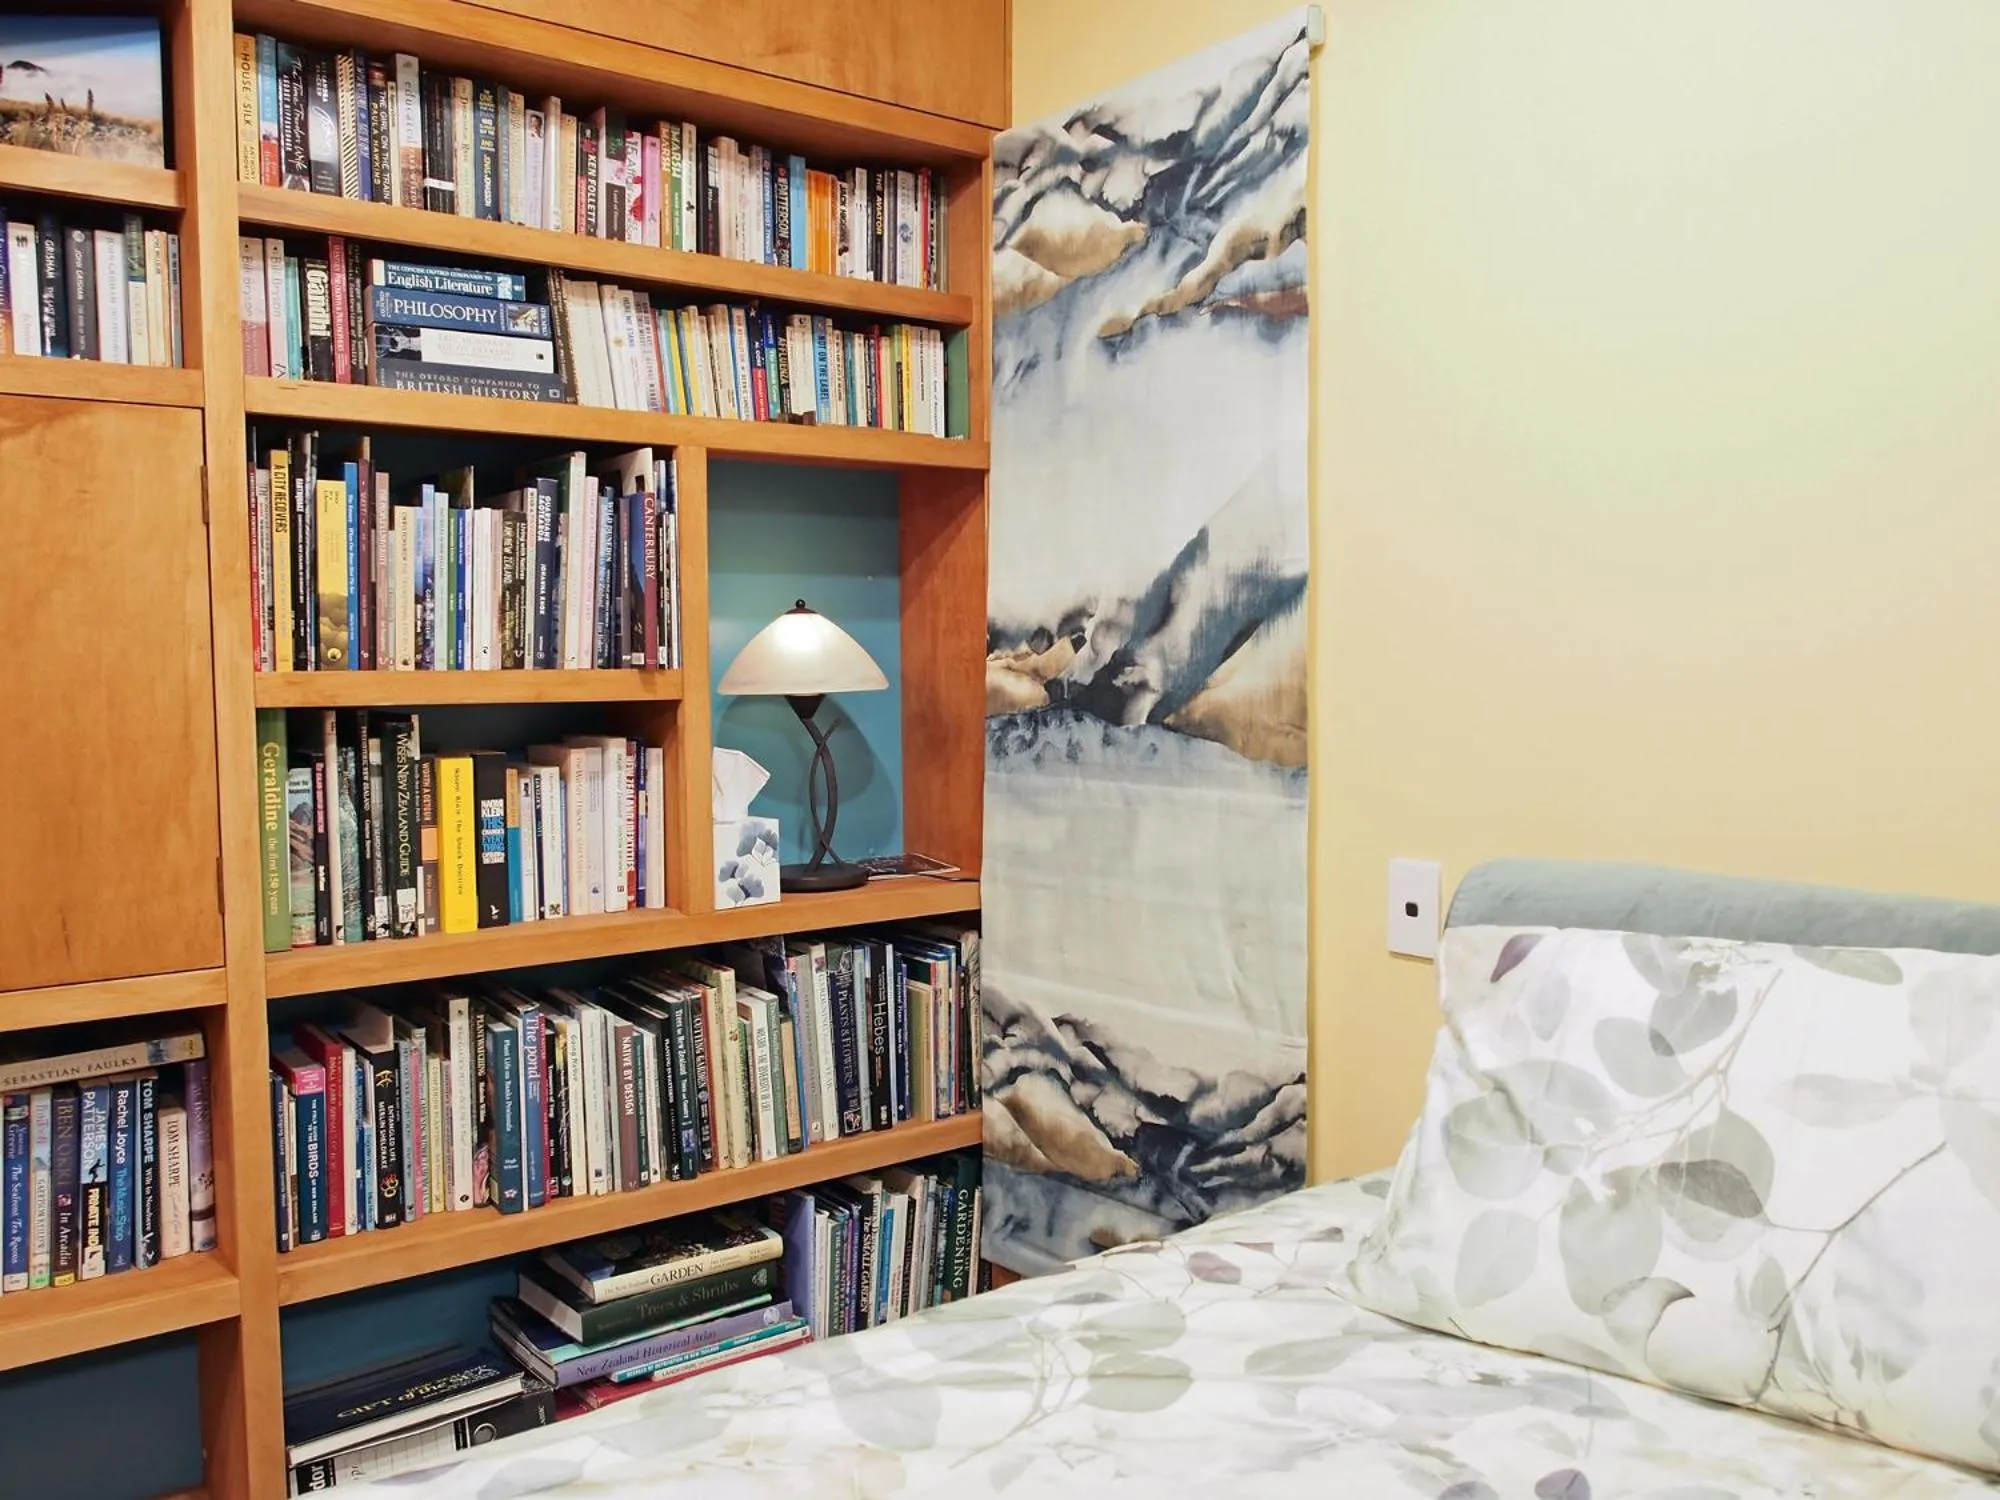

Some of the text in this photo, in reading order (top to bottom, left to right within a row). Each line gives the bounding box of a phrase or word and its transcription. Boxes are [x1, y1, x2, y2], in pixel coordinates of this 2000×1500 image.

[241, 51, 253, 127] HOUSE SILK
[288, 144, 308, 172] Wife
[371, 102, 382, 185] PAULA HAWKINS
[379, 90, 392, 200] THE GIRL ON THE TRAIN
[661, 128, 671, 173] MARSH
[671, 130, 681, 179] MARSH
[587, 154, 597, 223] KEN FOLLETT
[839, 184, 848, 206] JACK
[875, 173, 883, 236] THE AVIATOR
[778, 183, 789, 238] PATTERSON
[44, 240, 56, 279] GRISHAM
[74, 249, 85, 300] JOHN GRISHAM
[242, 255, 253, 271] Bill
[270, 256, 282, 319] Bill Bryson
[306, 269, 331, 336] Gandhi
[388, 271, 493, 296] English Literature
[394, 298, 498, 325] PHILOSOPHY
[395, 371, 540, 390] THE OXFORD COMPANION TO
[777, 336, 790, 385] AFFLUENZA
[818, 335, 829, 401] NOT ON THE LABEL
[395, 379, 540, 402] BRITISH HISTORY
[274, 471, 287, 490] CITY
[275, 491, 288, 534] RECOVERS
[519, 522, 527, 541] Living
[542, 495, 552, 542] GUARDIANS
[606, 501, 615, 525] WILD
[644, 497, 657, 581] CANTERBURY
[503, 555, 514, 584] ZEALAND
[396, 764, 411, 791] NEW
[421, 762, 431, 788] WORTH
[262, 741, 283, 916] Geraldine the first 150 years
[397, 791, 412, 842] ZEALAND
[422, 793, 432, 822] DETOUR
[399, 843, 413, 877] GUIDE
[837, 990, 850, 1029] PLANTS
[872, 1002, 887, 1056] Hebes
[476, 1014, 486, 1077] PLANTWATCHING
[503, 1039, 512, 1057] Plant
[524, 1015, 541, 1079] The pond
[663, 1038, 673, 1066] PLANTING
[674, 1008, 688, 1076] Trees New Zealand
[693, 1018, 708, 1089] CUTTING GARDEN
[841, 1036, 854, 1085] FLOWERS
[3, 1056, 138, 1087] SEBASTIAN FAULKS
[505, 1080, 514, 1101] Banks
[621, 1036, 635, 1116] NATIVE BY DESIGN
[56, 1104, 74, 1139] BEN
[81, 1090, 96, 1171] PATTERSON
[95, 1107, 107, 1151] JAMES
[113, 1089, 130, 1164] Rachel Joyce
[142, 1079, 155, 1164] TOM SHARPE
[378, 1101, 390, 1170] MERLIN SHELDRAKE
[386, 1104, 397, 1162] ENTANGLED LIFE
[505, 1101, 514, 1132] Peninsula
[7, 1122, 19, 1160] Greene
[165, 1119, 181, 1187] TOM SHARPE
[307, 1142, 321, 1179] BIRDS
[11, 1164, 23, 1184] The
[144, 1167, 153, 1183] Wilt
[87, 1187, 100, 1226] PRIVATE
[113, 1167, 128, 1242] The Music Shop
[144, 1195, 154, 1231] Nowhere
[11, 1218, 23, 1235] Tea
[58, 1211, 73, 1266] In Arcadia
[951, 1188, 970, 1290] GARDENING
[10, 1236, 22, 1264] Rooms
[859, 1215, 873, 1313] The SMALL GARDEN
[650, 1262, 704, 1286] GARDEN
[636, 1279, 740, 1317] Trees & Shrubs
[575, 1364, 598, 1378] New
[601, 1351, 640, 1372] Zealand
[644, 1335, 692, 1360] Historical
